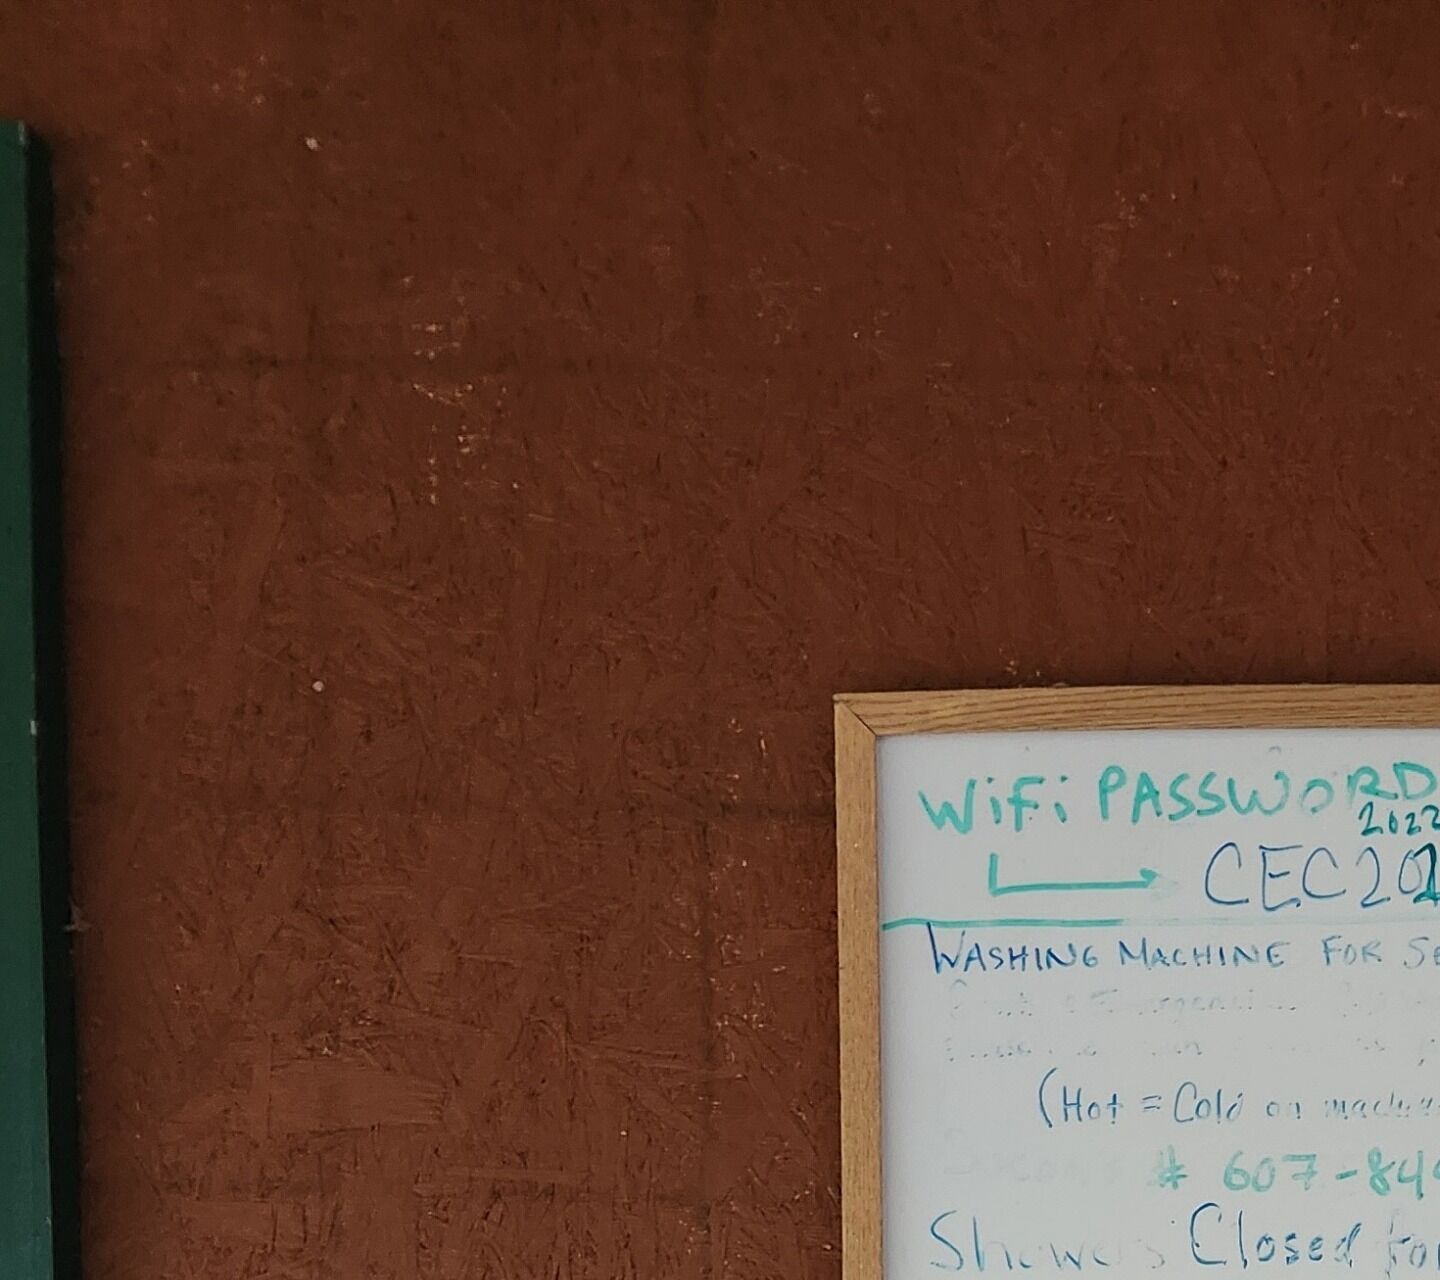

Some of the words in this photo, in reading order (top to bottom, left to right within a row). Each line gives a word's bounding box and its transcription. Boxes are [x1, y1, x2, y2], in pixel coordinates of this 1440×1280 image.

[918, 774, 1068, 834] WiFi
[1099, 762, 1438, 822] PASSWORD
[926, 922, 1099, 973] WASHING
[1119, 940, 1285, 968] MACHINE
[1323, 942, 1382, 965] FOR
